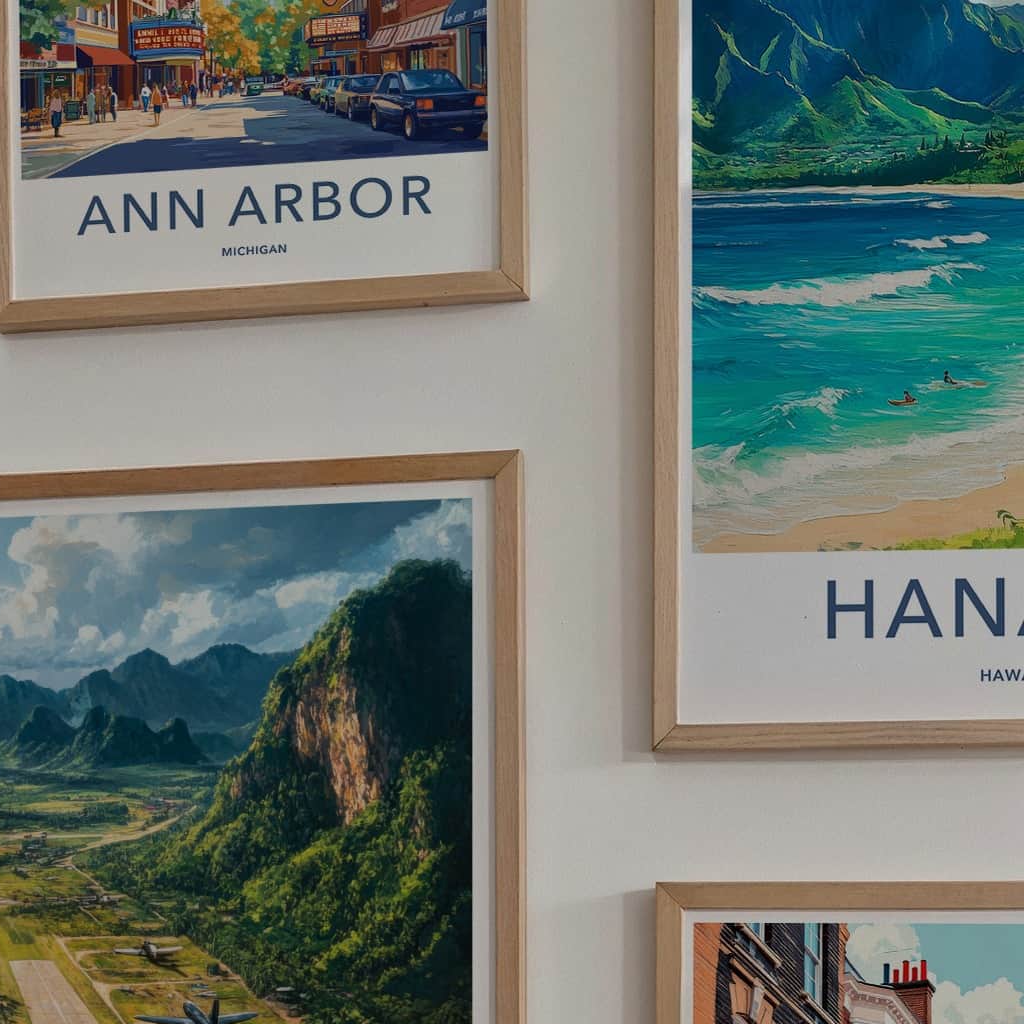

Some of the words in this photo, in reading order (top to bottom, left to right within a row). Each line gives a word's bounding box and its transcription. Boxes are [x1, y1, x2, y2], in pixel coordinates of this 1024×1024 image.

[76, 189, 205, 236] ANN
[228, 176, 432, 227] ARBOR
[221, 243, 288, 257] MICHIGAN
[826, 577, 1024, 640] HAN
[980, 668, 1024, 682] HAW
